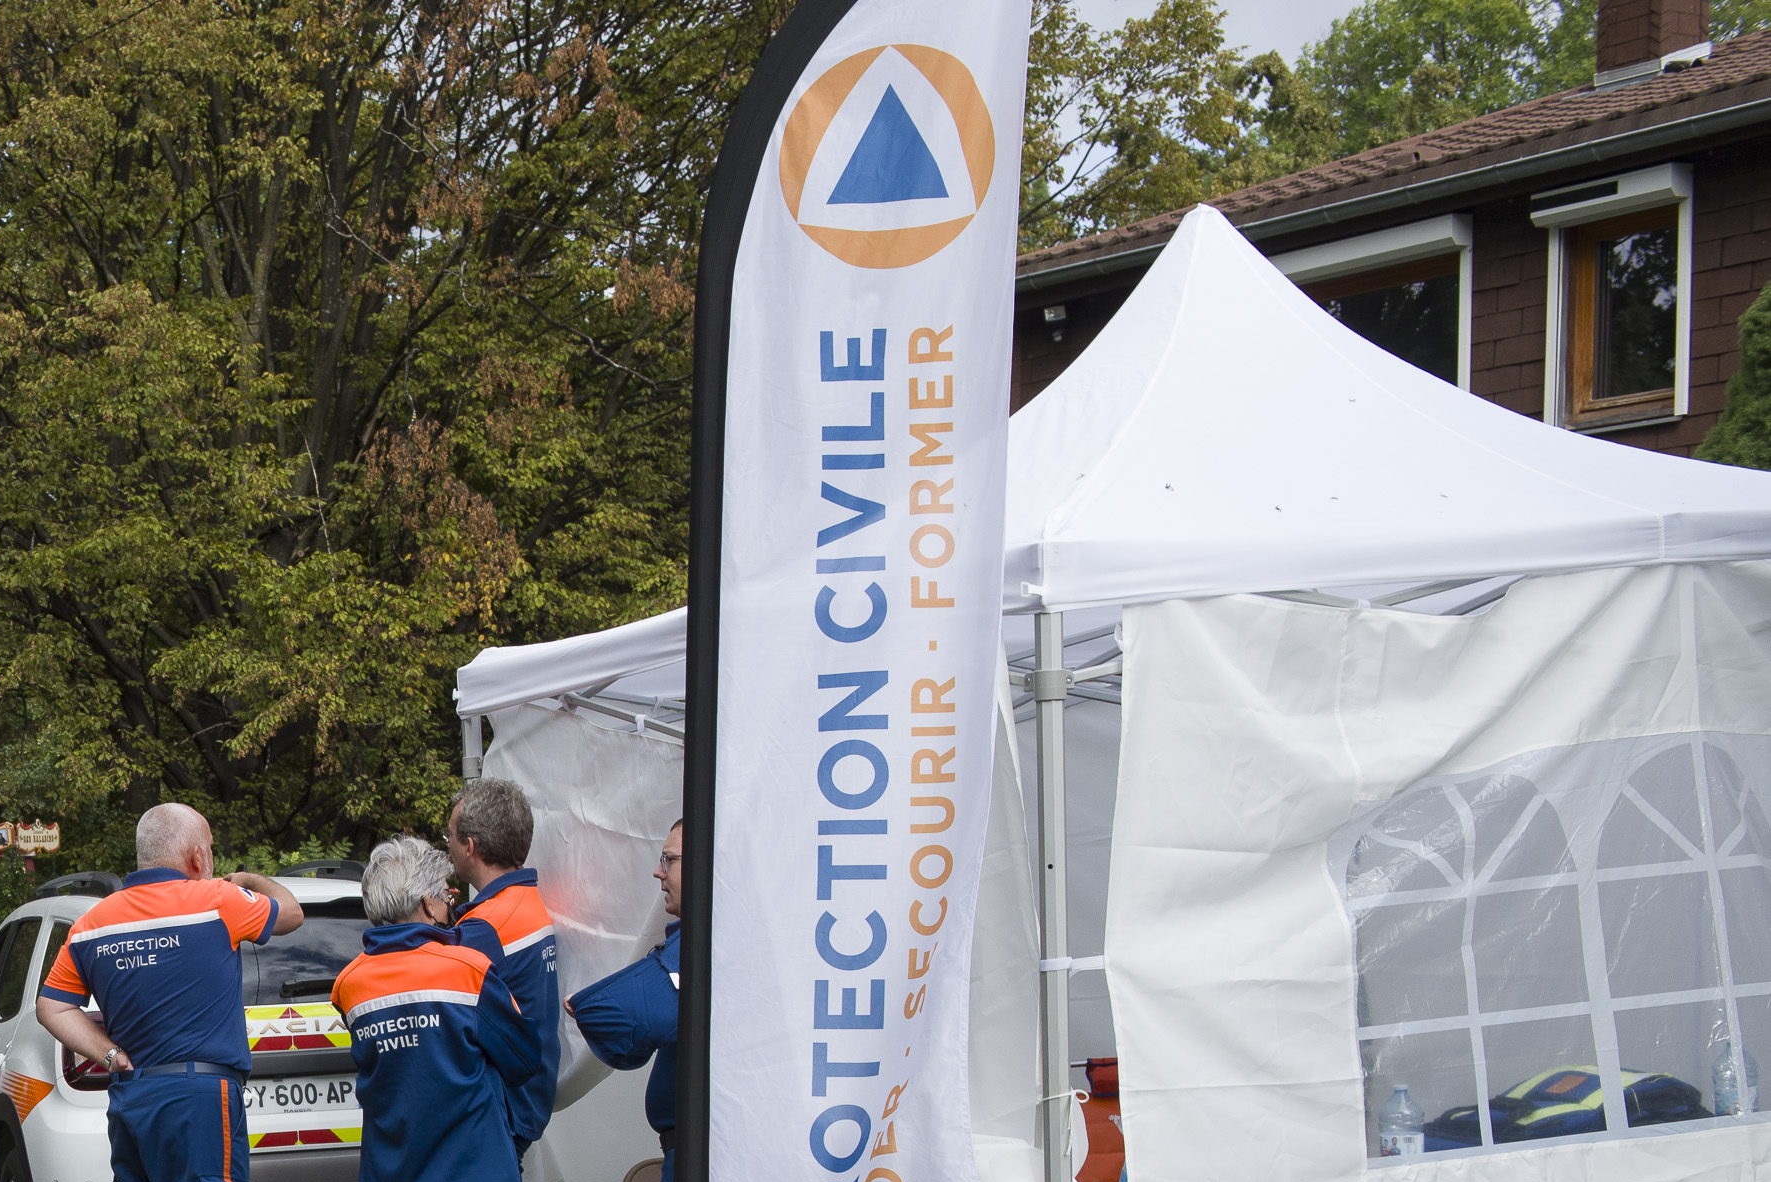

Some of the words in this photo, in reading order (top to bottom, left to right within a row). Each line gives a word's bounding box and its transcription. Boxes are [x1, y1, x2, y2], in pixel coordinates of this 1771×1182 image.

[908, 324, 956, 609] FORMER
[814, 328, 889, 644] CIVILE
[903, 676, 956, 1020] SECOURIR
[96, 934, 181, 959] PROTECTION
[115, 953, 158, 970] CIVILE
[355, 1013, 440, 1042] PROTECTION
[375, 1033, 420, 1054] CIVILE
